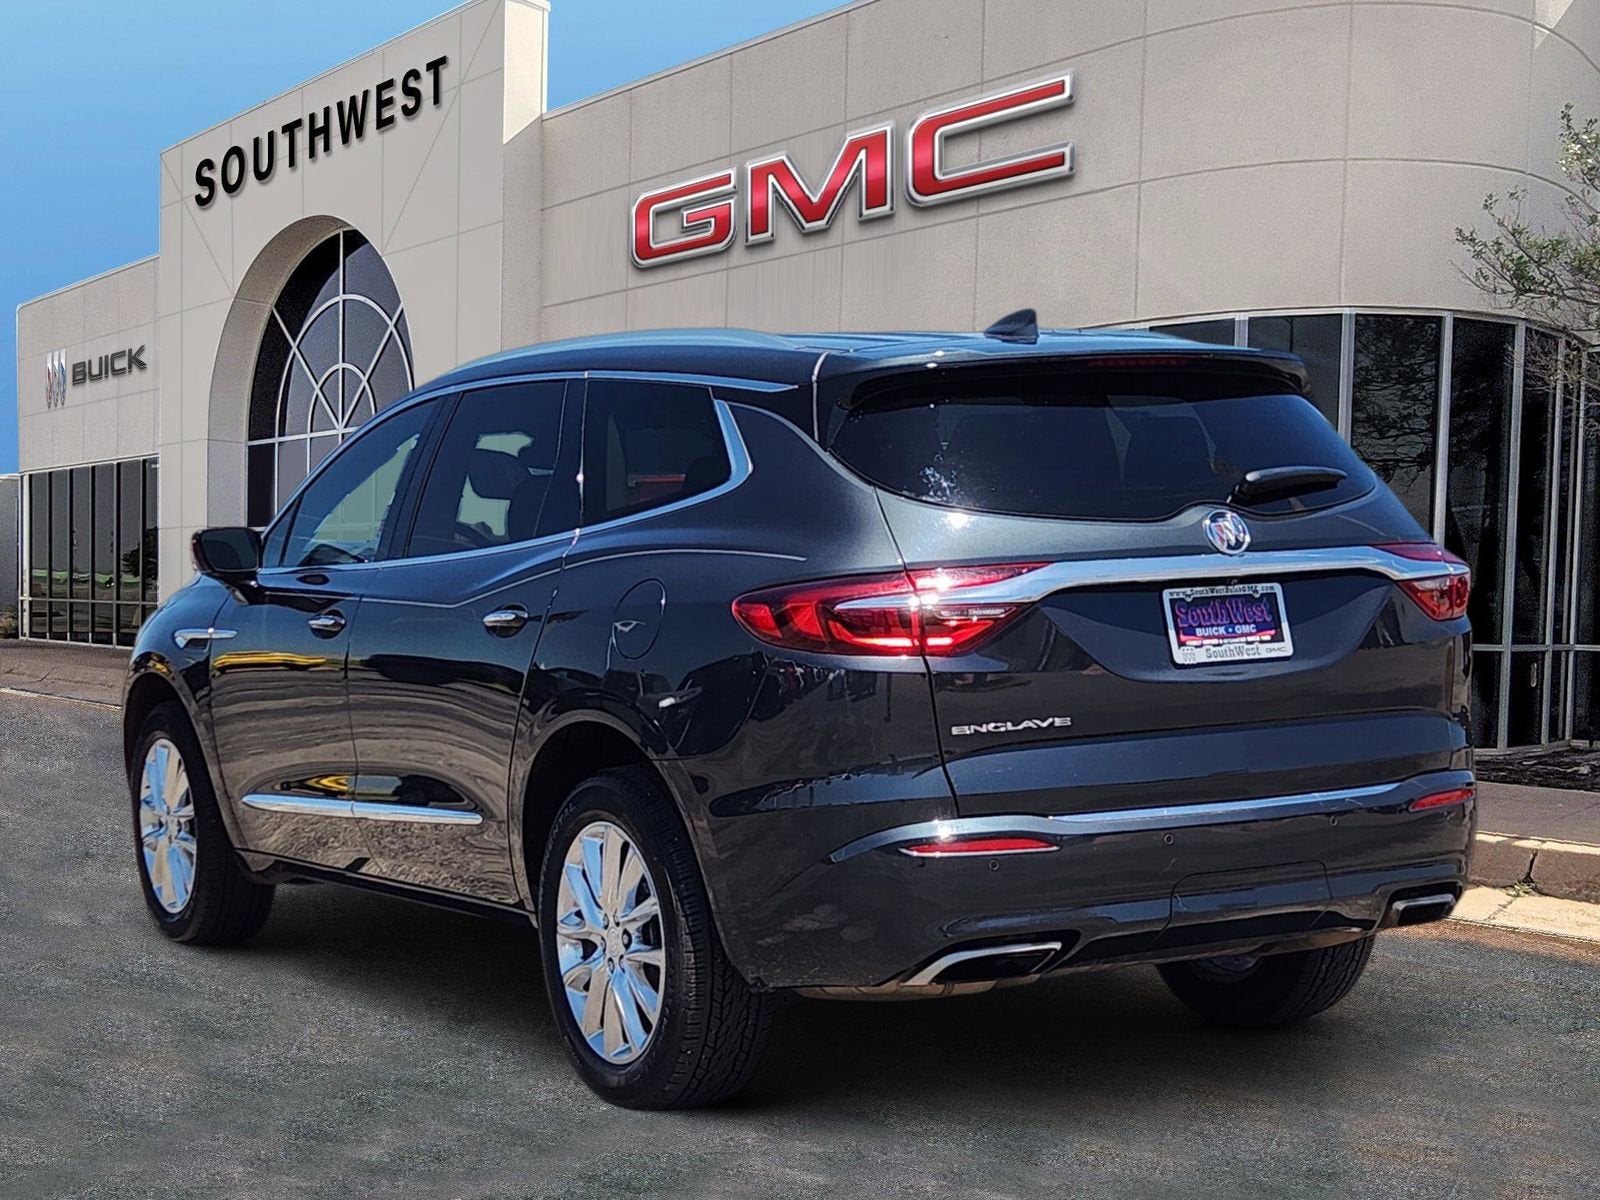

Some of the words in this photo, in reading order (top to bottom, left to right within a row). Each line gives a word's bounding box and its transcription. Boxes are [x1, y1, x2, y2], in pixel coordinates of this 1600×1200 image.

[194, 55, 447, 207] SOUTHWEST
[630, 68, 1075, 268] GMC
[72, 344, 147, 385] BUICK
[1174, 598, 1272, 627] SouthWest
[1195, 625, 1226, 636] BUICK
[1234, 624, 1257, 634] GMC
[1205, 645, 1262, 659] SouthWest
[951, 717, 1072, 736] ENCLAVE
